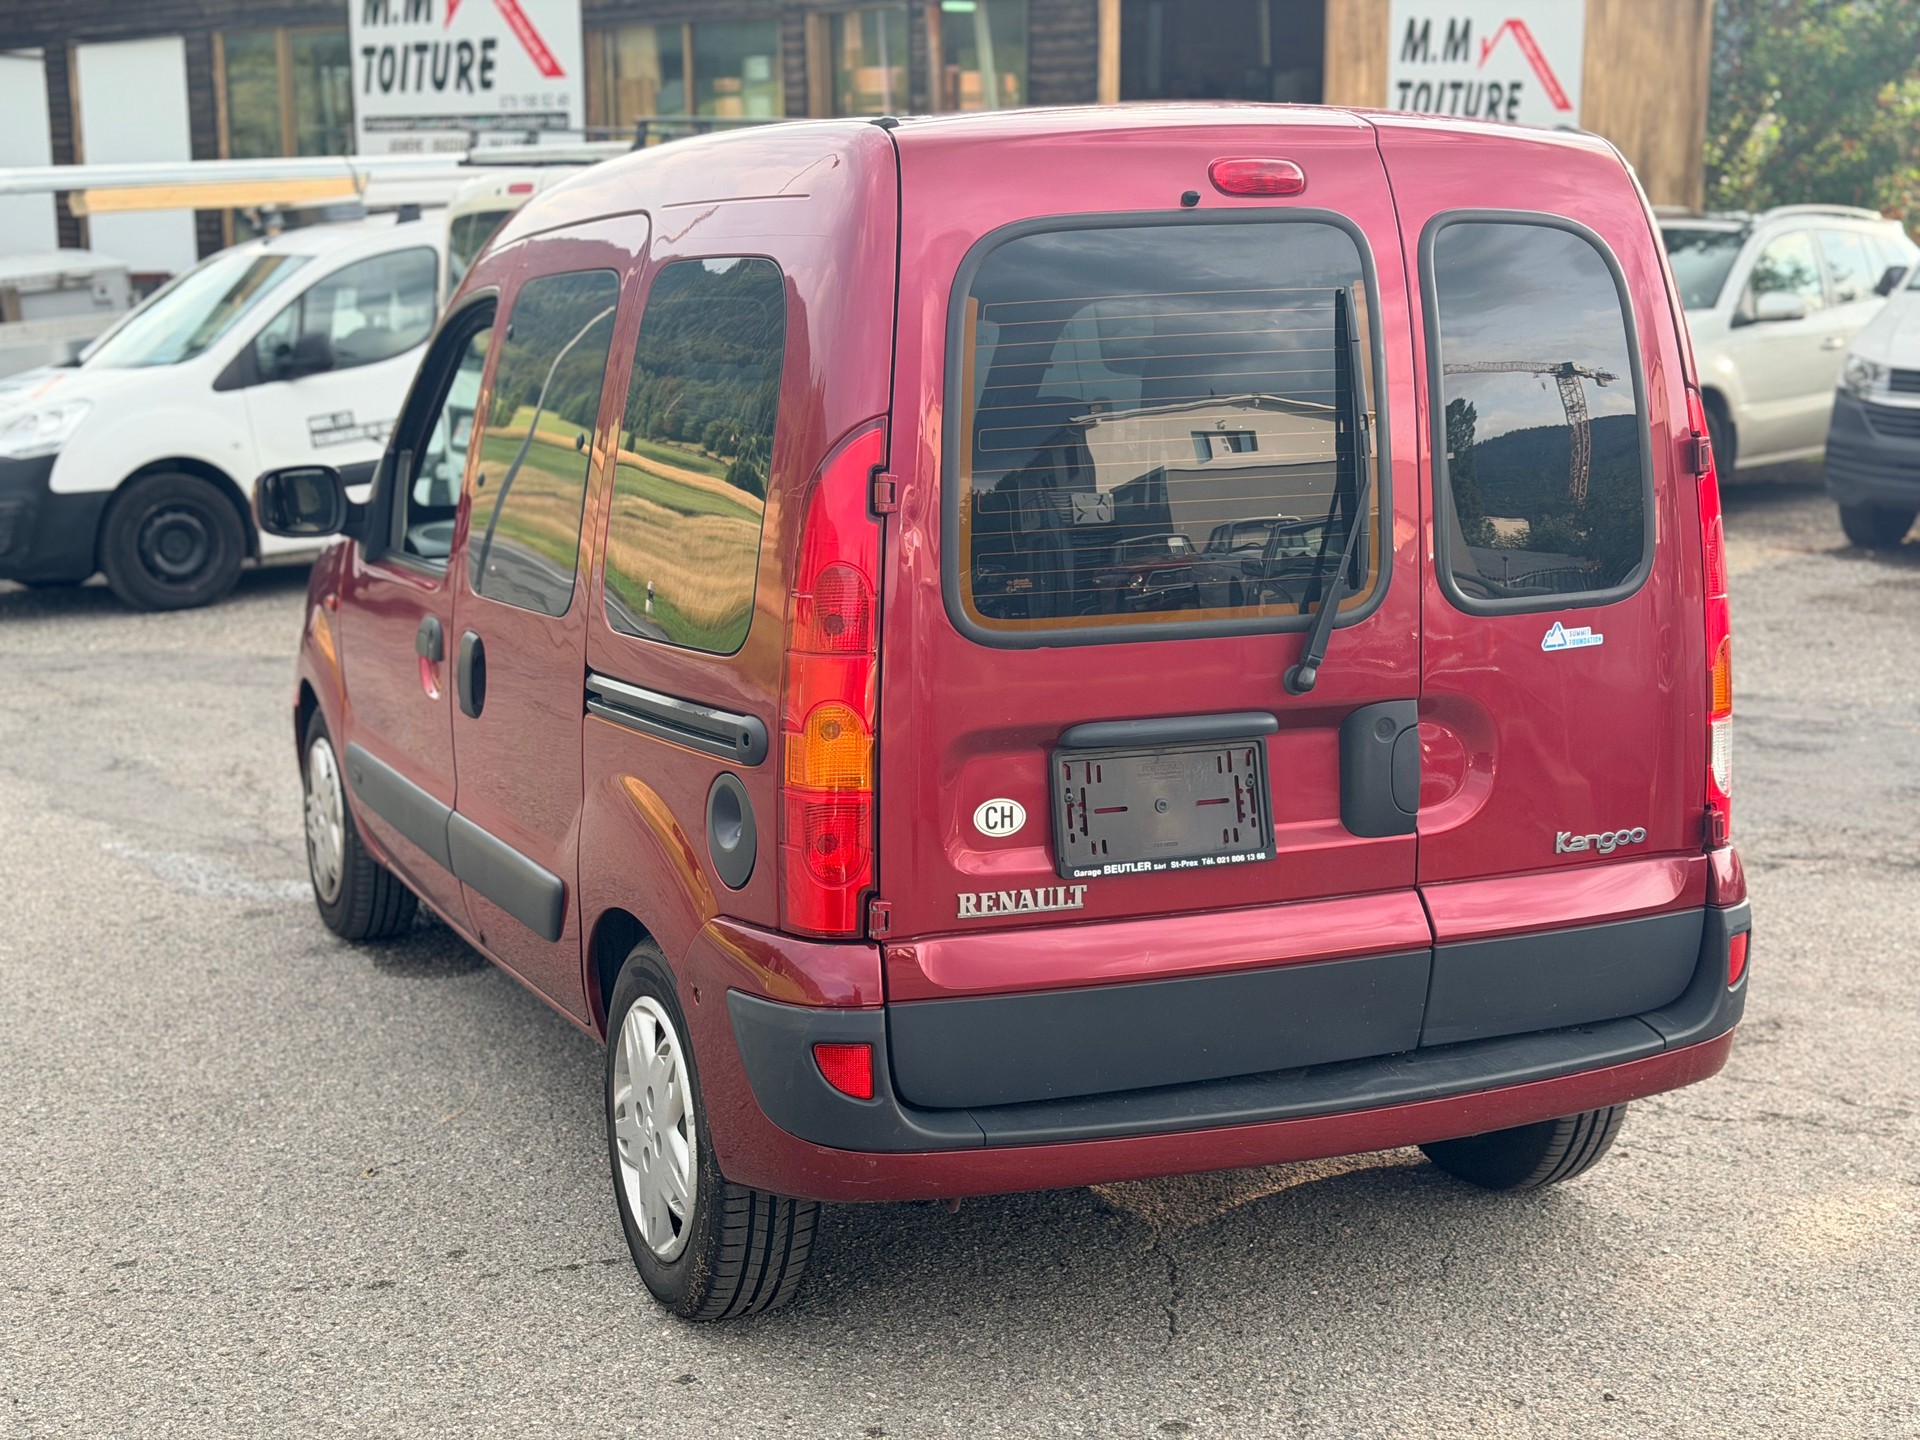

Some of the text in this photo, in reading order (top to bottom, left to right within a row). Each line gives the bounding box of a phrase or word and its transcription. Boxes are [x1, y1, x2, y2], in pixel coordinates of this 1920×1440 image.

[1400, 18, 1472, 63] M.M
[362, 38, 497, 94] TOITURE
[1397, 81, 1523, 120] TOITURE
[1568, 635, 1602, 646] FOUNDATION
[1569, 628, 1590, 637] SUMMIT
[985, 806, 1014, 830] CH
[1555, 827, 1647, 854] Kangoo
[1073, 869, 1102, 877] Garage
[1103, 861, 1152, 875] BEUTLER
[1170, 860, 1199, 868] St-Prex
[1201, 857, 1216, 866] Tél.
[1216, 856, 1230, 864] 021
[1231, 854, 1246, 862] 806
[1246, 853, 1256, 861] 13
[957, 884, 1088, 919] RENAULT
